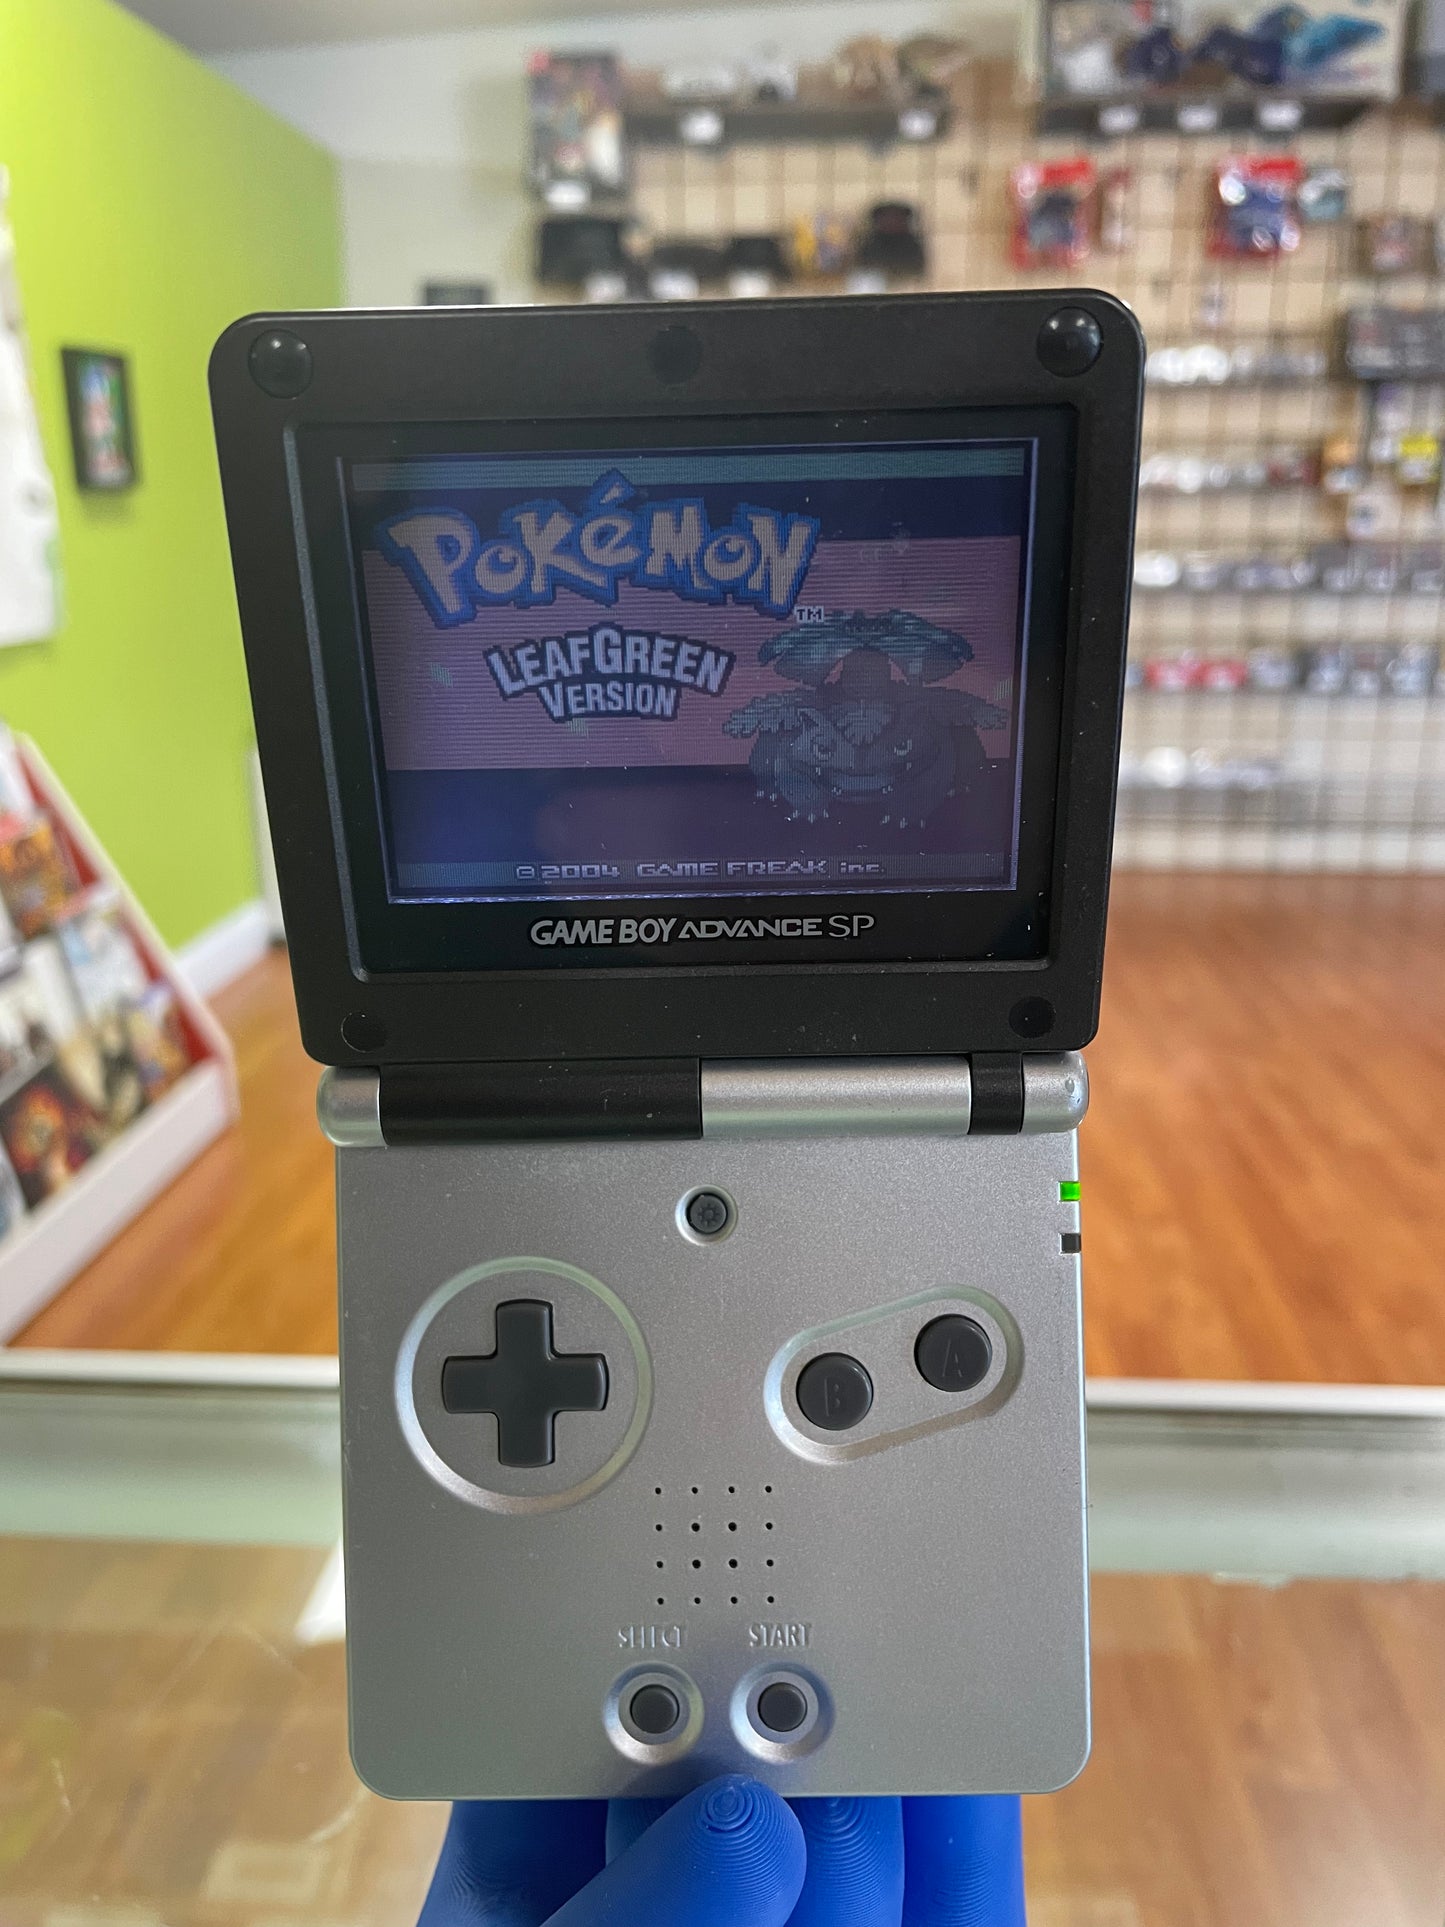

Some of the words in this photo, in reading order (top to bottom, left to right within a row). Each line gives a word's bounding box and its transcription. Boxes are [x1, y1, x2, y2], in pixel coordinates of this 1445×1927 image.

[487, 628, 731, 694] LEAFGREEN
[539, 681, 678, 719] VERSION
[637, 862, 718, 877] GAME
[727, 860, 827, 876] FREAK
[530, 919, 614, 945] GAME
[619, 918, 677, 943] BOY
[678, 918, 822, 938] ADVANCE
[828, 915, 875, 938] SP
[749, 1623, 811, 1648] START
